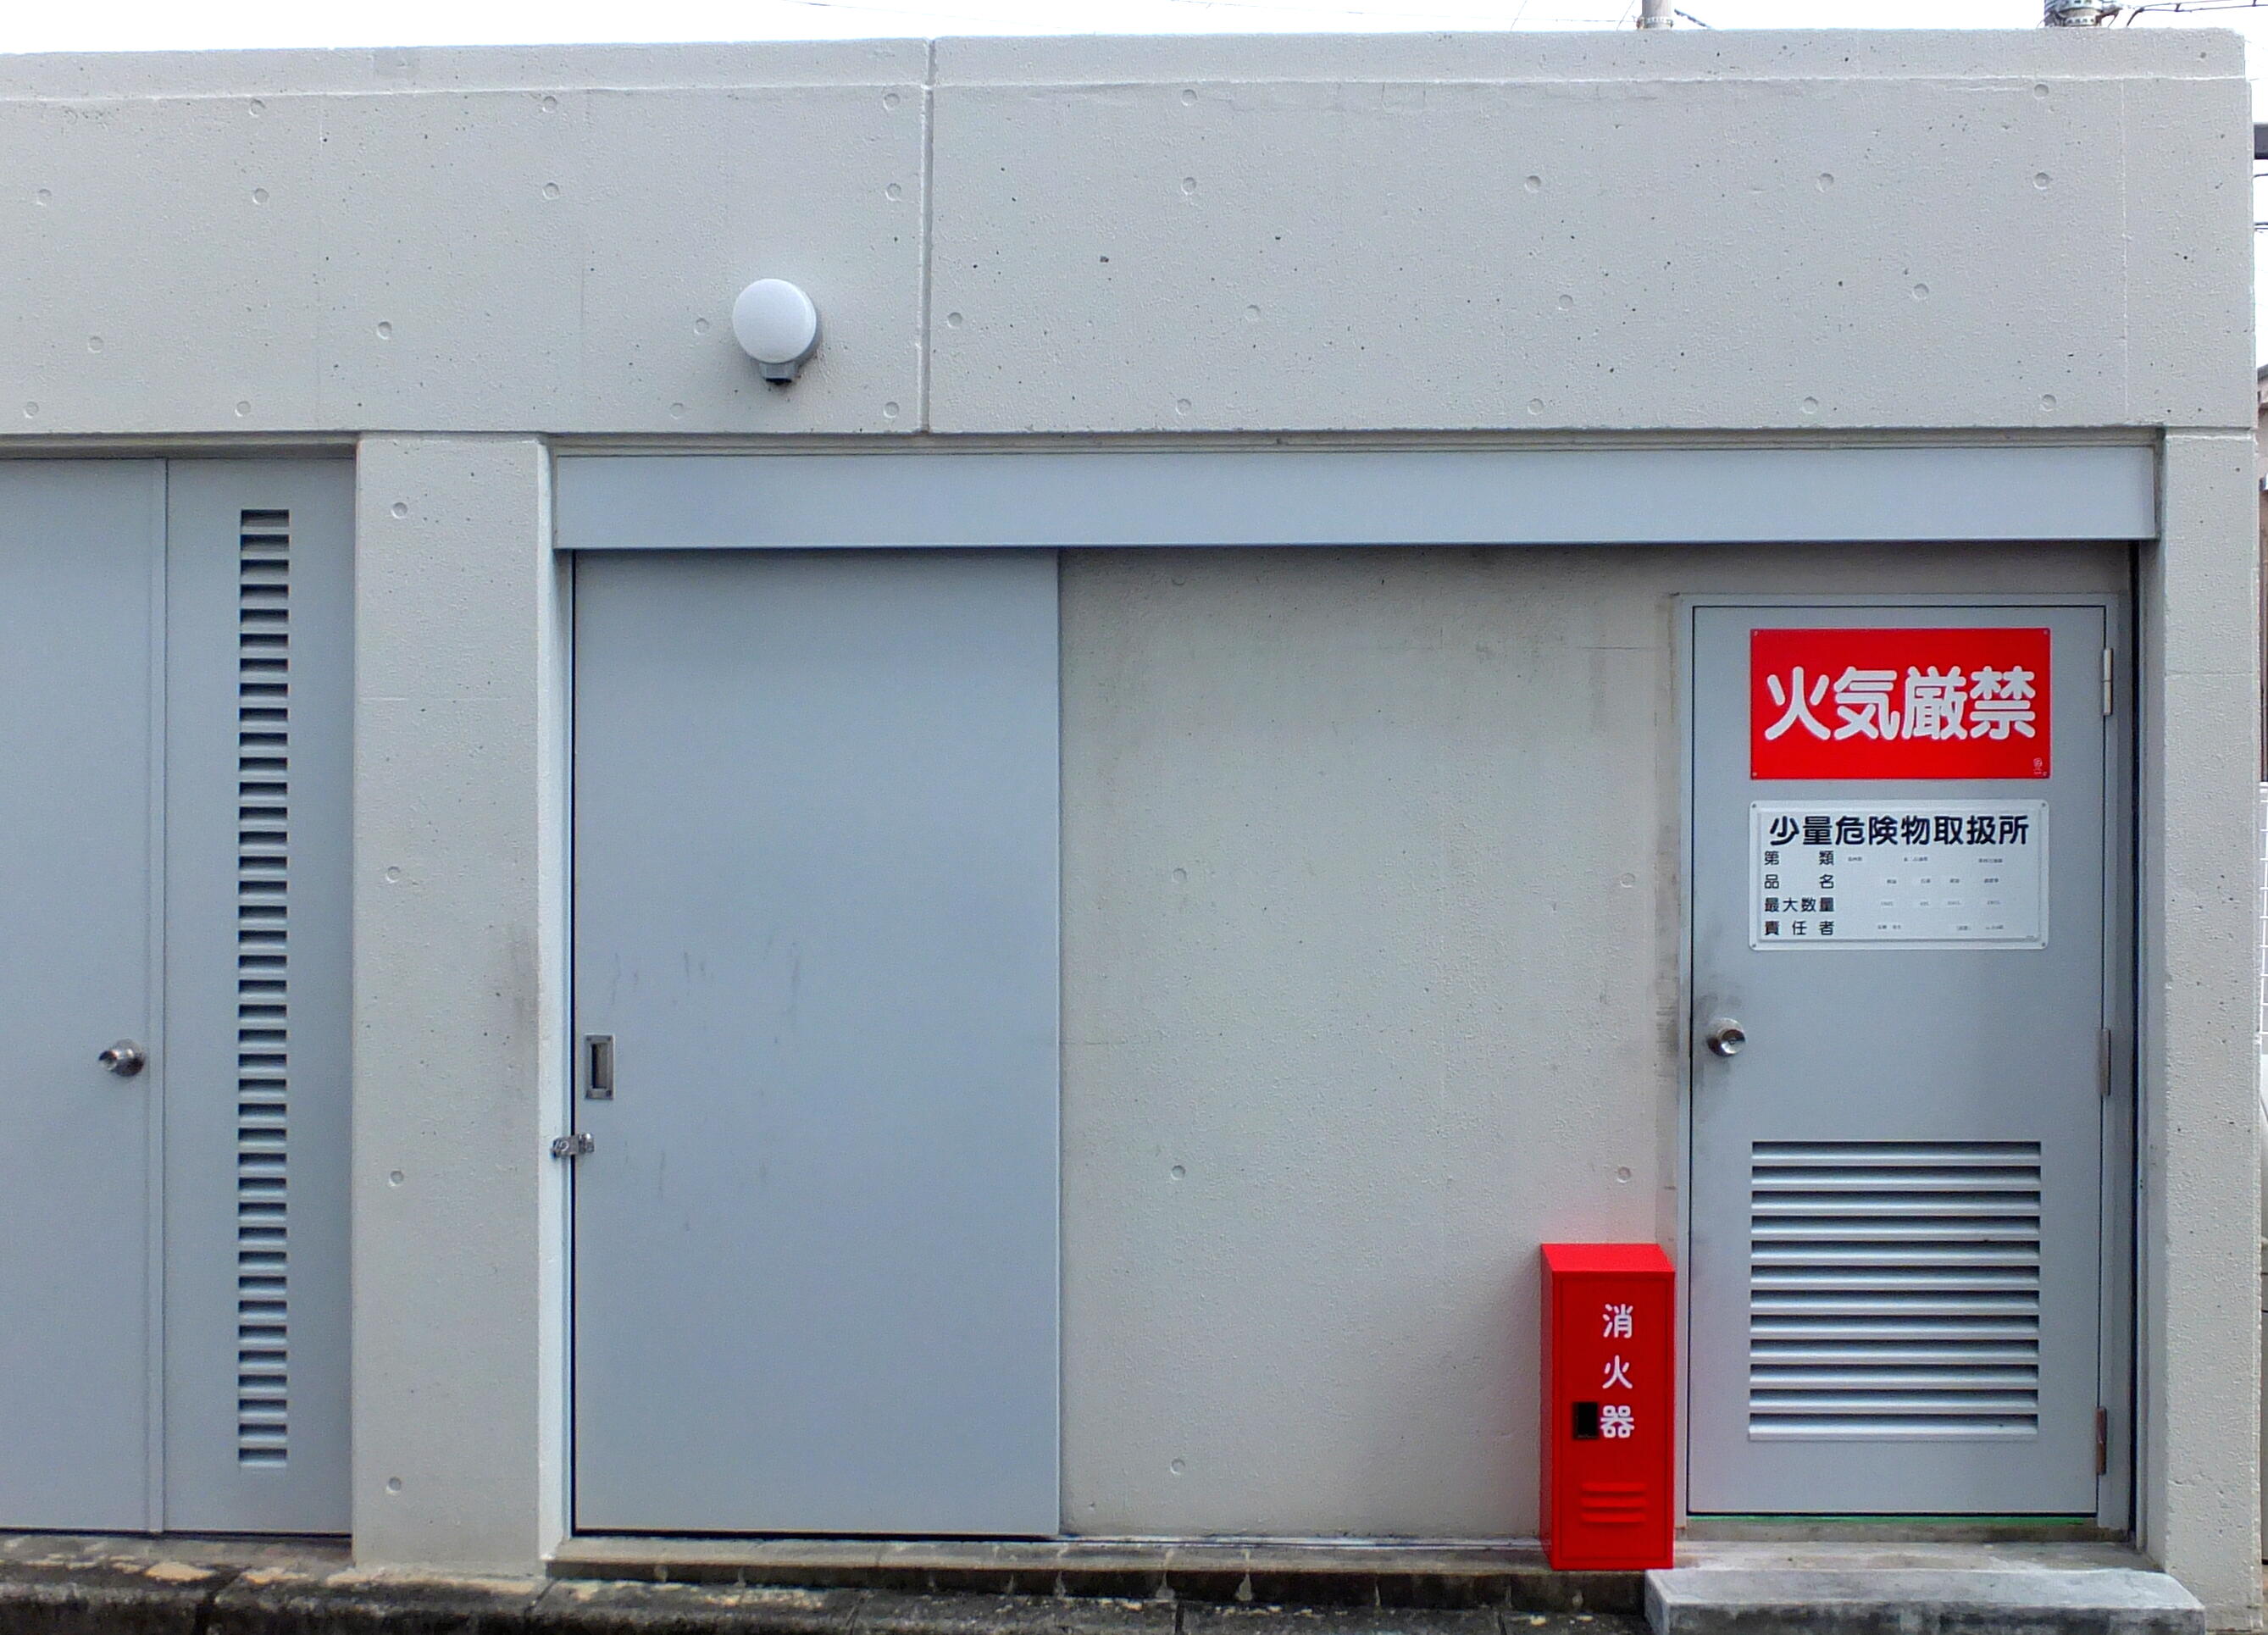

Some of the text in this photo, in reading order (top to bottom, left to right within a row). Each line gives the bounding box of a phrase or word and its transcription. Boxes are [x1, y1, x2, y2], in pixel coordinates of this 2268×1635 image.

[1765, 666, 2037, 740] 火気厳禁
[1769, 815, 2030, 846] 少量危険物取扱所
[1764, 897, 1835, 912] 最大数量
[1600, 1303, 1635, 1439] 消火器
